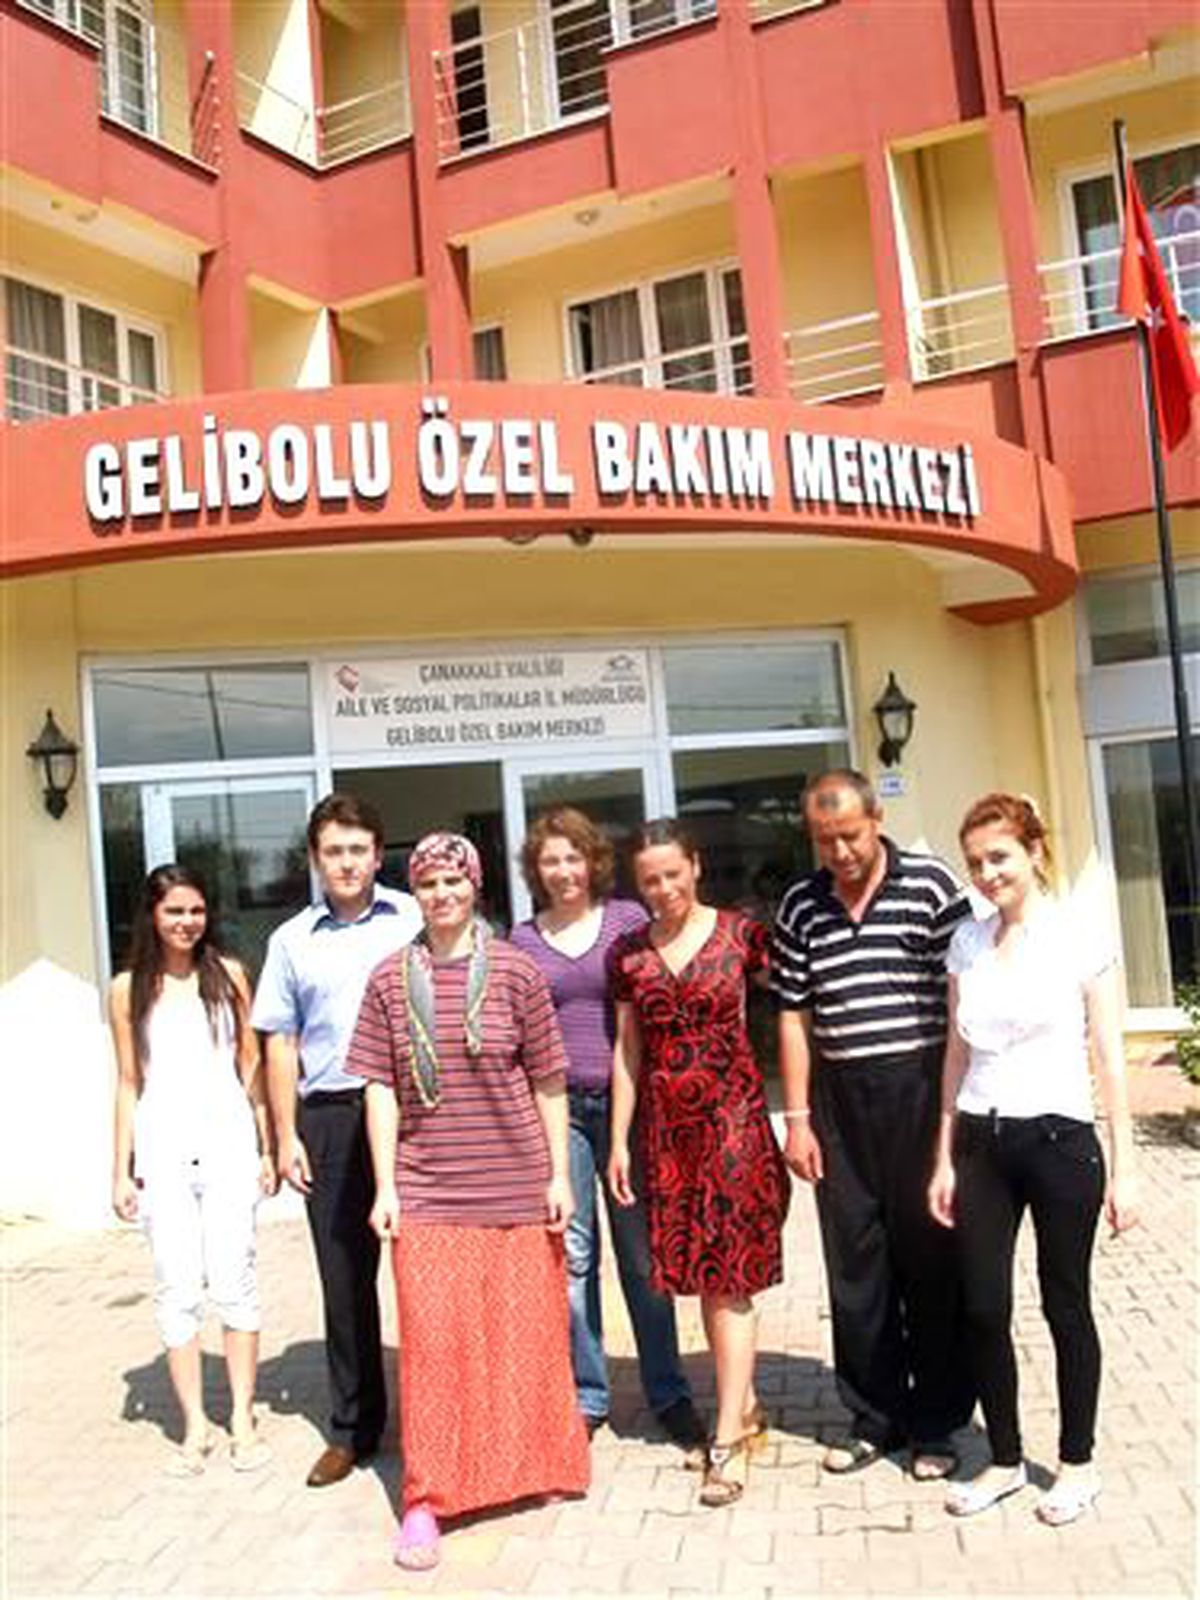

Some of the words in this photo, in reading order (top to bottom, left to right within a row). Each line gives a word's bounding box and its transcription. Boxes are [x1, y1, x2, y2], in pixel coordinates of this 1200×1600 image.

[84, 414, 391, 521] GELİBOLU
[417, 396, 574, 497] ÖZEL
[593, 421, 774, 499] BAKIM
[787, 432, 982, 517] MERKEZİ
[336, 697, 367, 717] AİLE
[372, 697, 391, 715] VE
[393, 694, 450, 715] SOSYAL
[453, 688, 541, 711] POLİTİKALAR
[387, 723, 455, 746] GELİBOLU
[459, 720, 493, 742] ÖZEL
[497, 720, 542, 739] BAKIM
[546, 716, 605, 737] MERKEZİ
